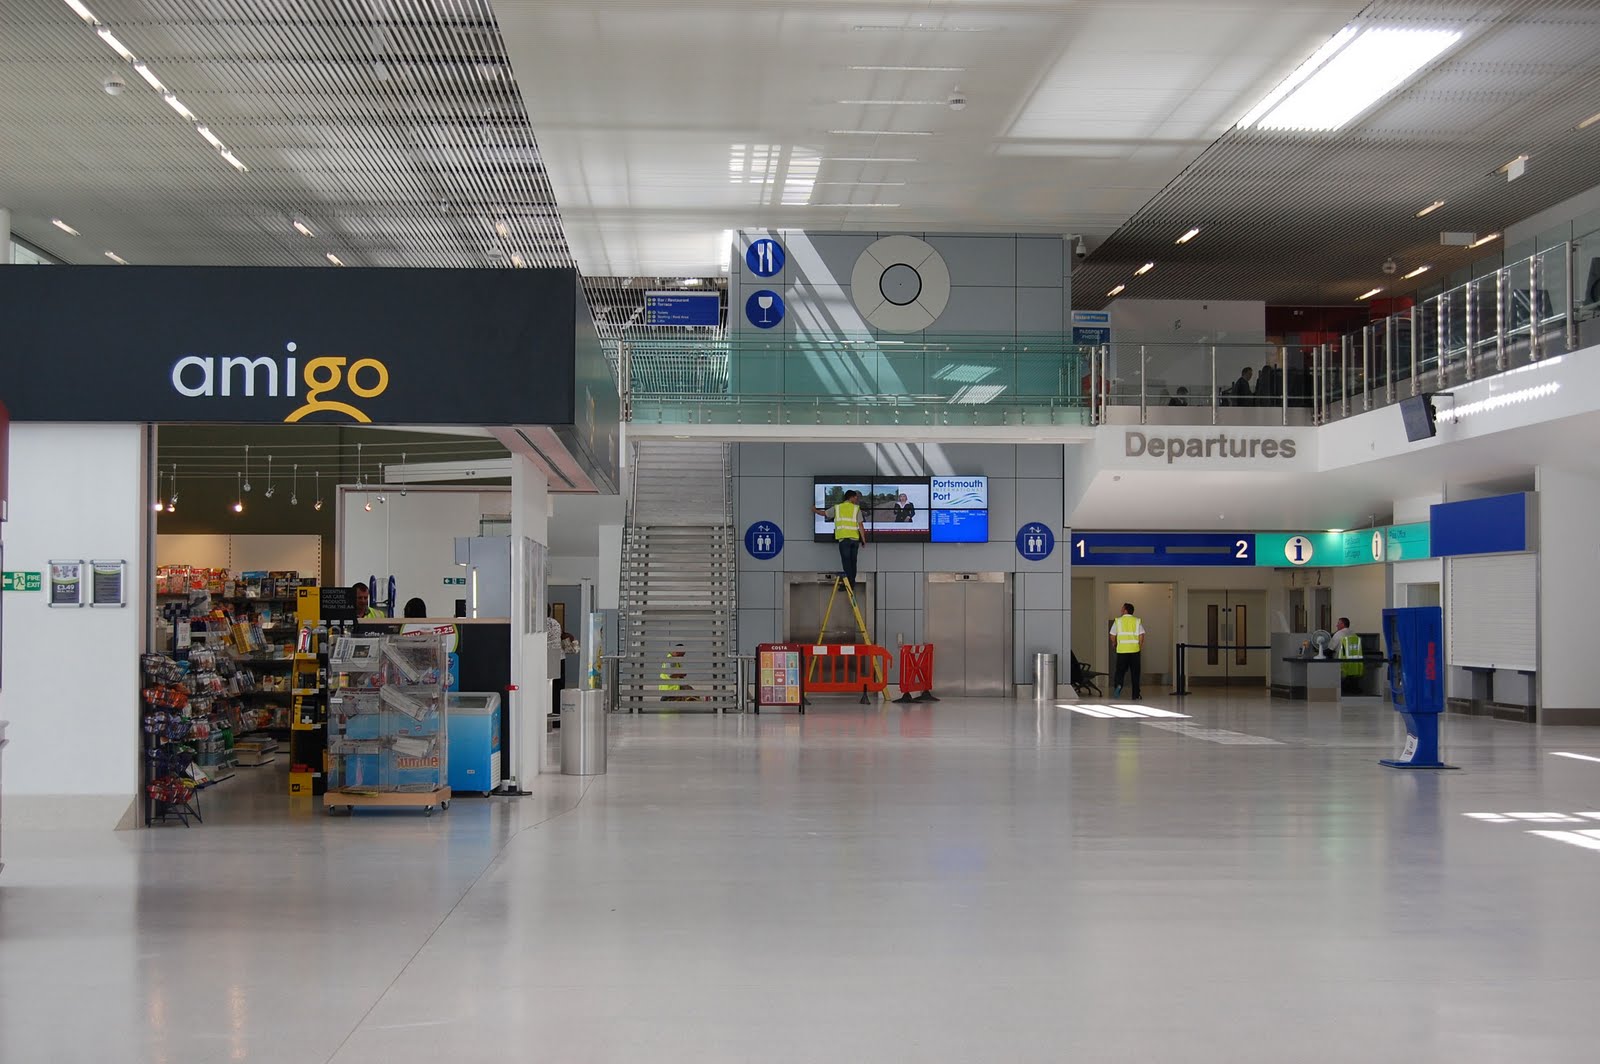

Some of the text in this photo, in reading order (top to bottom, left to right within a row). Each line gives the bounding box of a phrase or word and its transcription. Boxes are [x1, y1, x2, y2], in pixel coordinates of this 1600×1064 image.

[172, 341, 389, 423] amigo
[1125, 432, 1297, 463] Departures
[933, 480, 982, 488] Portsmouth
[1076, 541, 1085, 558] 1
[1236, 540, 1248, 558] 2
